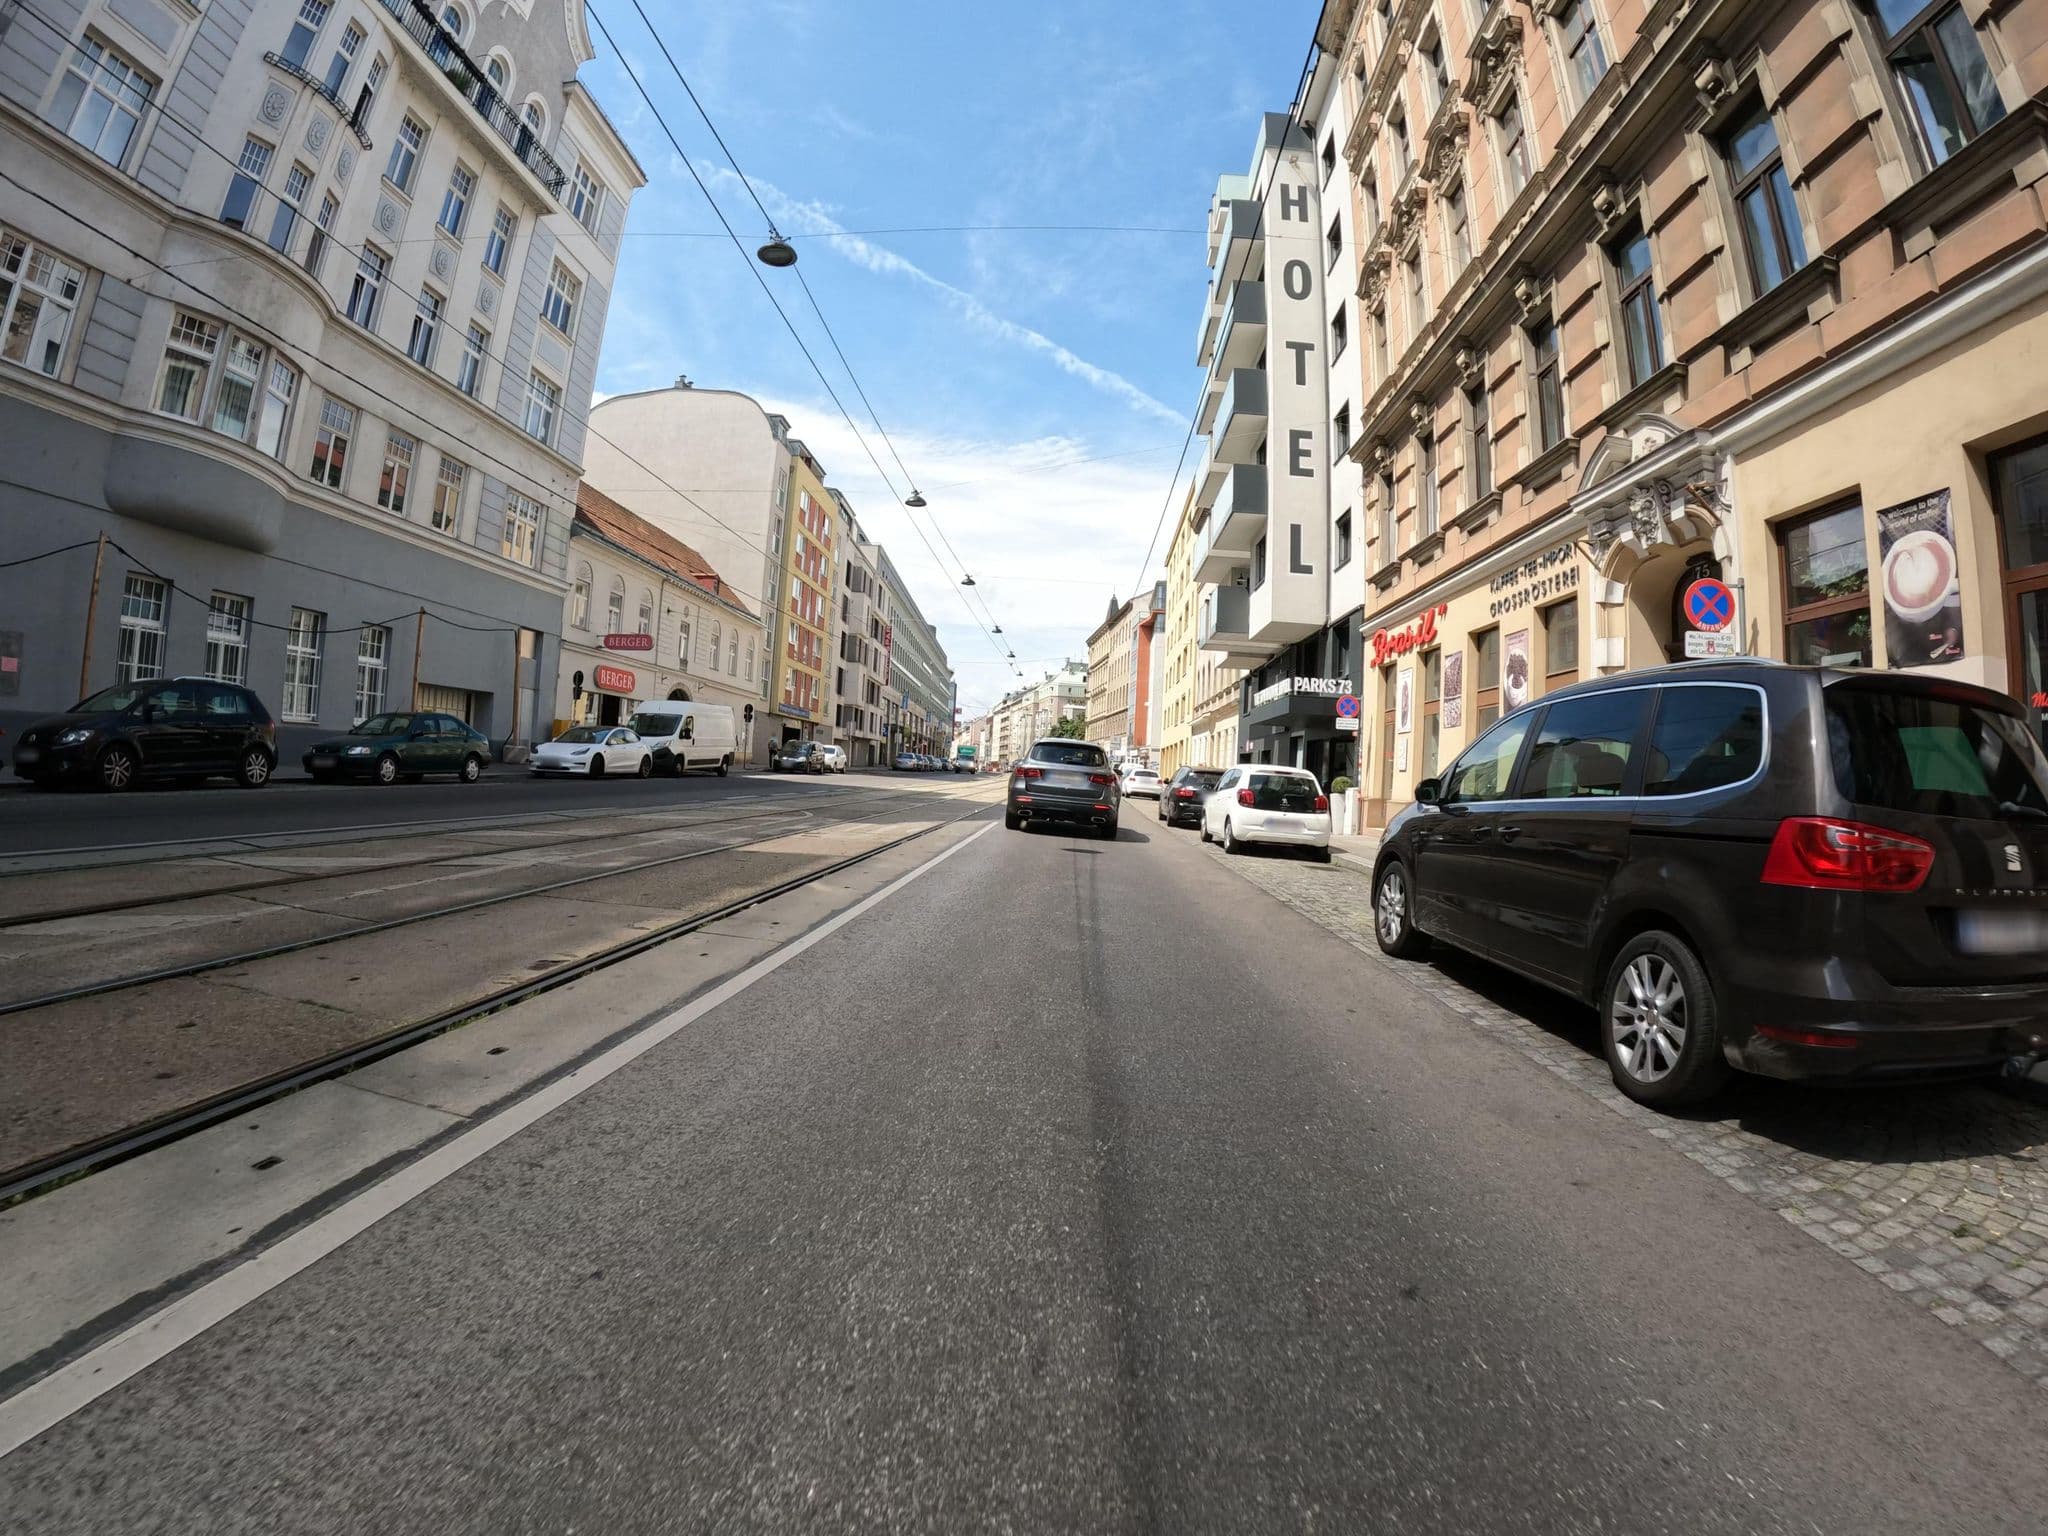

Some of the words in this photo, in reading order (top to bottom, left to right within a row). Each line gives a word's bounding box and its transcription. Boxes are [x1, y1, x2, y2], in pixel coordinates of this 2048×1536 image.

[1280, 183, 1315, 575] HOTEL
[1695, 564, 1710, 579] 75
[1490, 565, 1579, 618] GROSSRÖSTEREI
[1696, 621, 1725, 632] ANFANG
[609, 637, 648, 647] BERGER
[600, 669, 633, 691] BERGER
[1294, 677, 1336, 694] PARKS
[1337, 680, 1353, 694] 73
